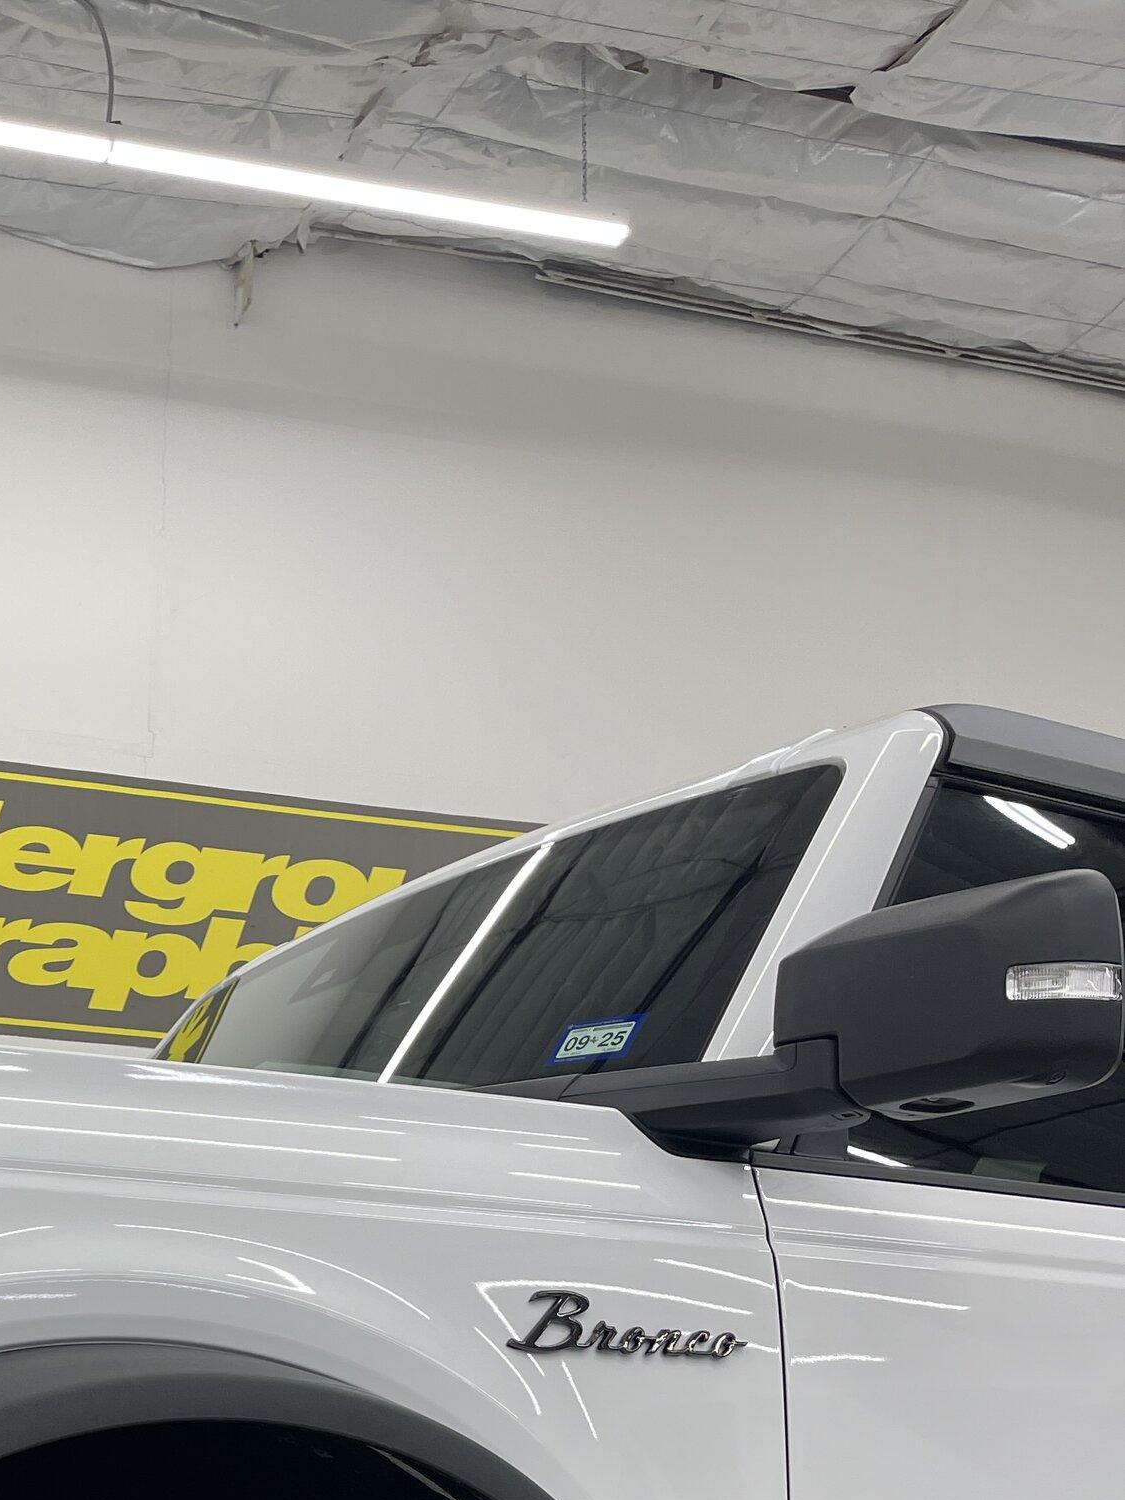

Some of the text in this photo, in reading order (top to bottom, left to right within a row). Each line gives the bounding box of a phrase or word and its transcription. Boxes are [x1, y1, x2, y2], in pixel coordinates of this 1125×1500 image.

[563, 1030, 628, 1053] 09 25
[506, 1290, 749, 1358] Bronco
